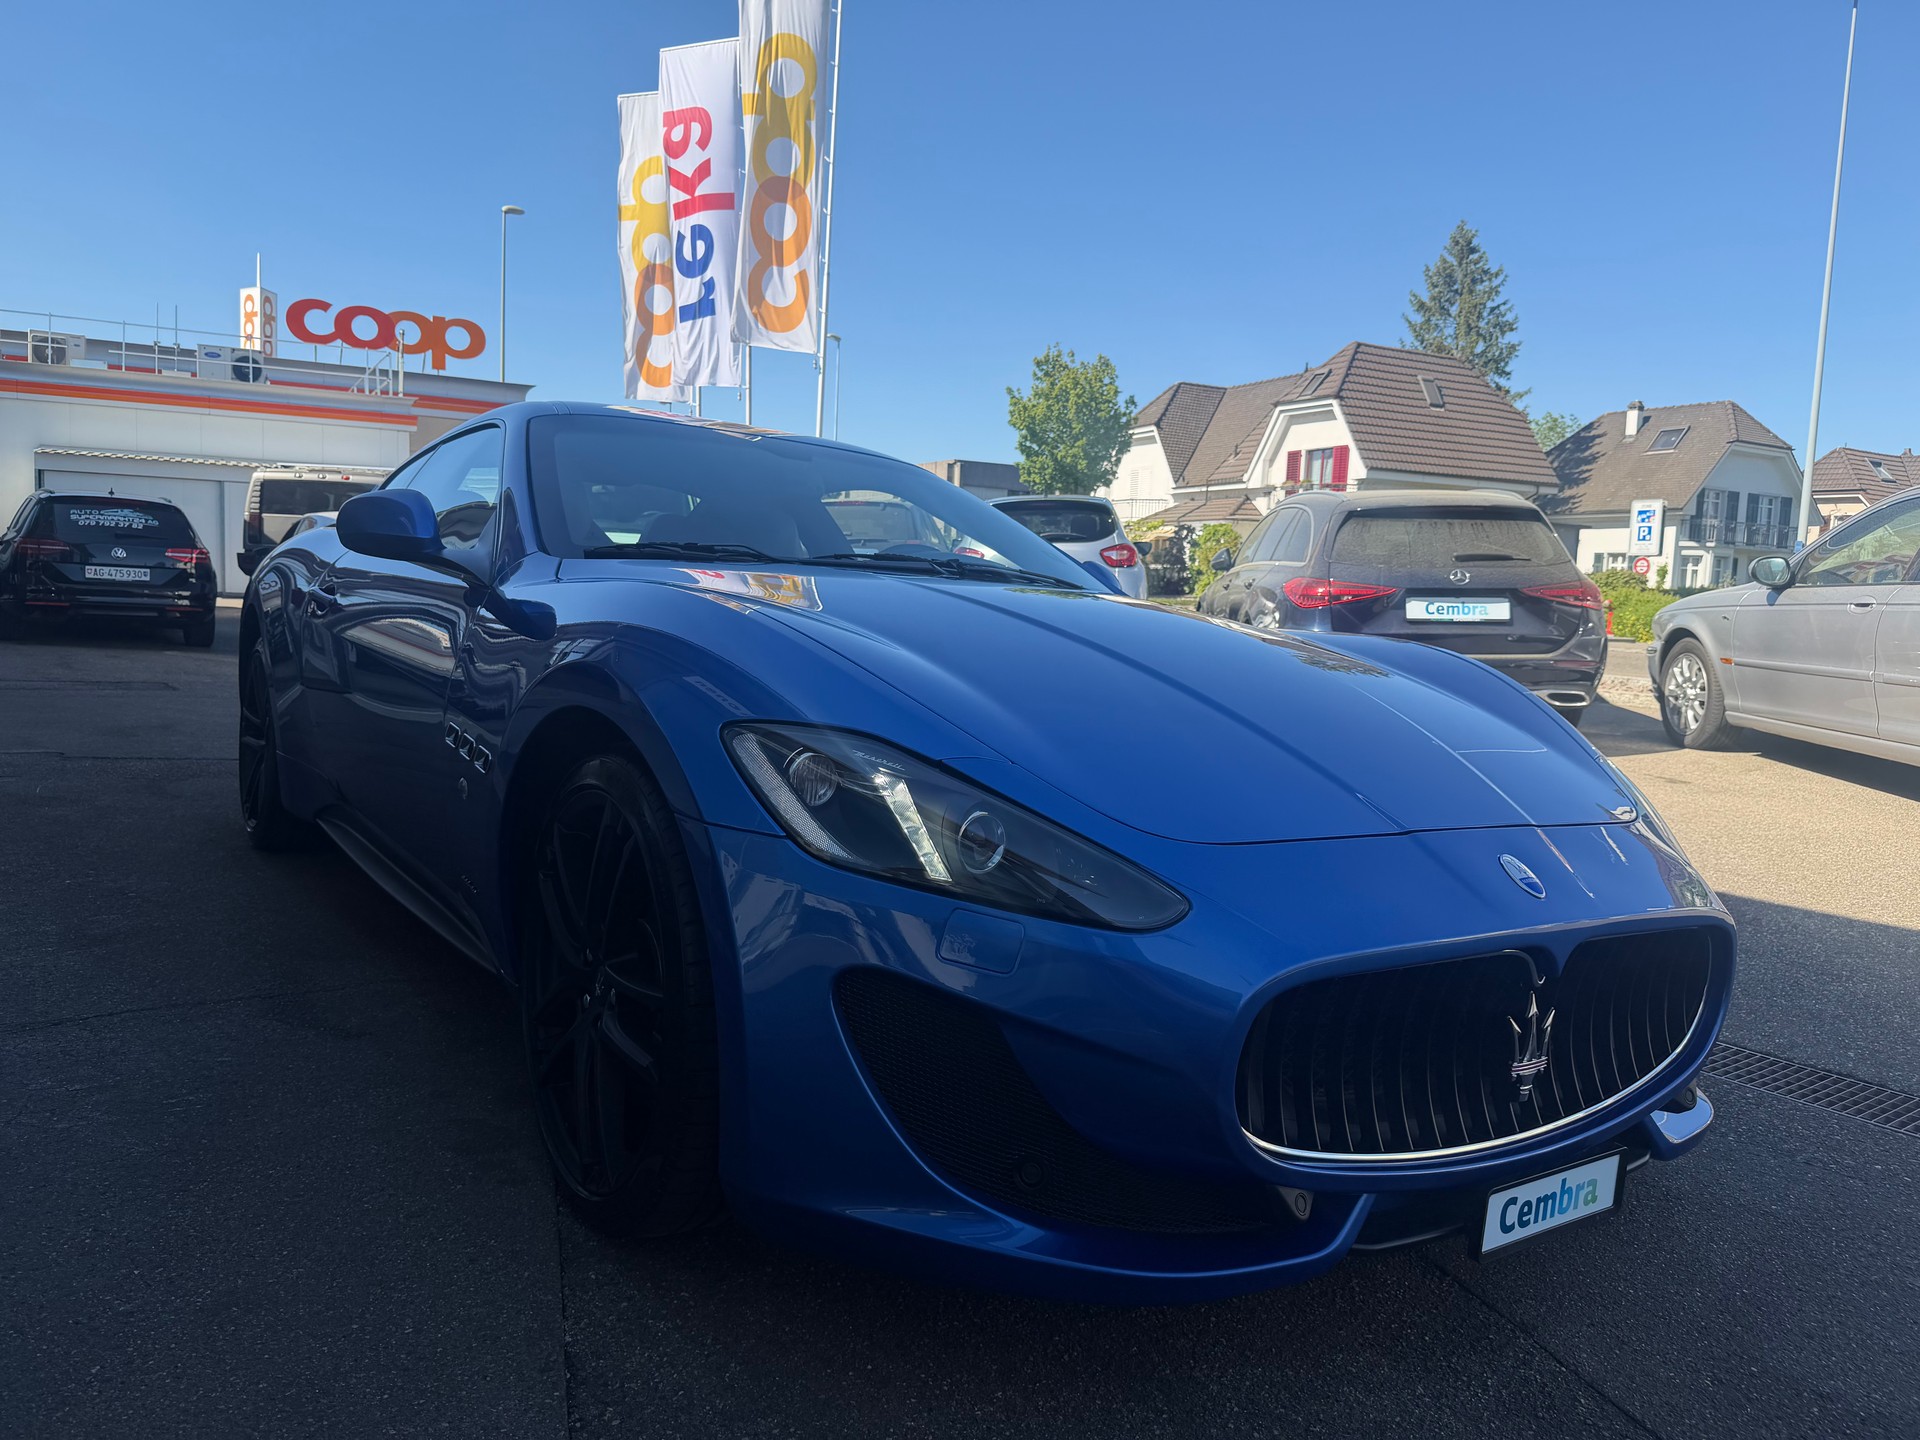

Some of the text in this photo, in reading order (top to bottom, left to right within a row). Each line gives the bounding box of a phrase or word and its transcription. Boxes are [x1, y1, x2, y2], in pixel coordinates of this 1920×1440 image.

[285, 298, 486, 371] coop
[1425, 601, 1489, 616] Cembra
[1499, 1177, 1598, 1235] Cembra
